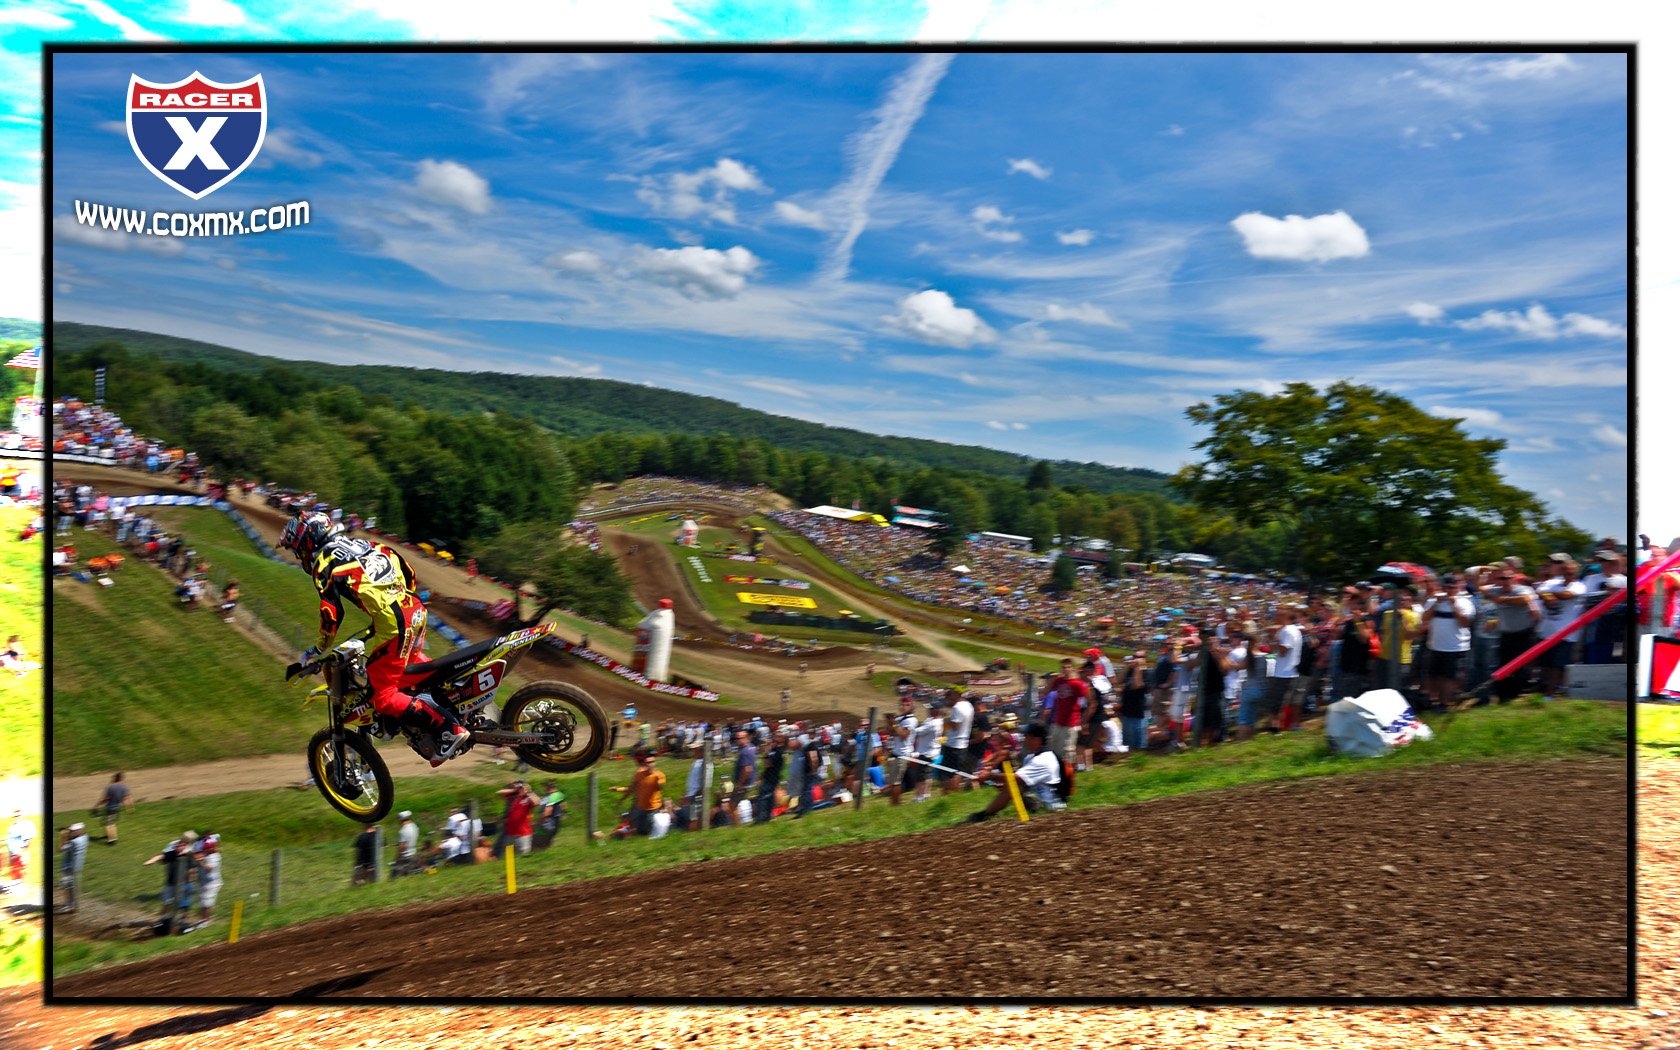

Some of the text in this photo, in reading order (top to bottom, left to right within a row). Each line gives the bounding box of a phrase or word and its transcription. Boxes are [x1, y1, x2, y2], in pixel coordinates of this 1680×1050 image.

[454, 658, 474, 669] SUZUKI
[477, 668, 496, 692] 5
[473, 692, 494, 706] SUZUKI
